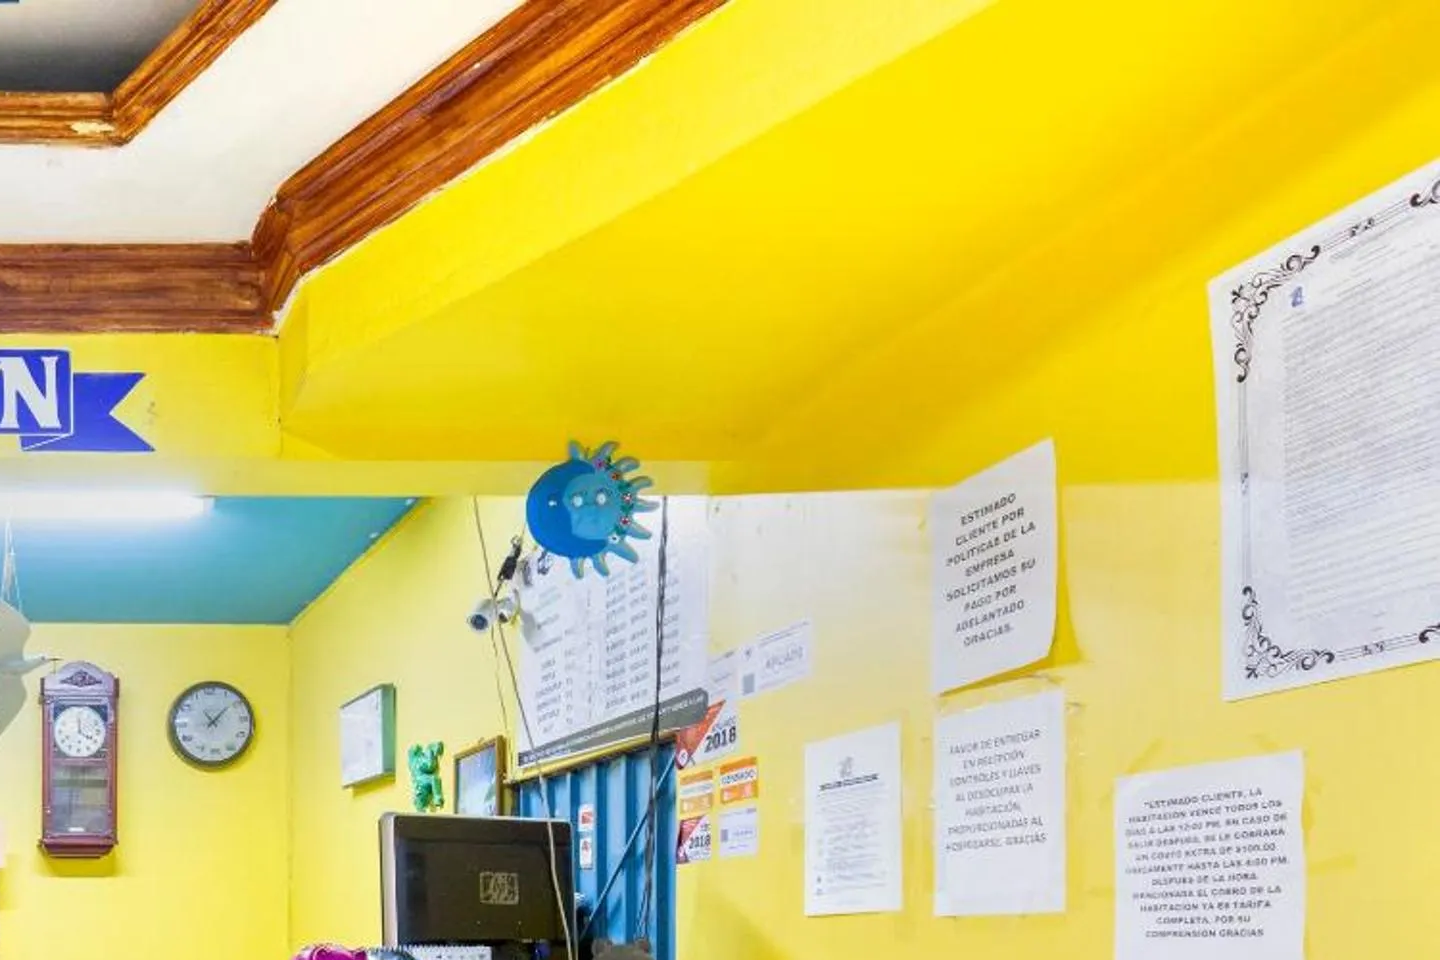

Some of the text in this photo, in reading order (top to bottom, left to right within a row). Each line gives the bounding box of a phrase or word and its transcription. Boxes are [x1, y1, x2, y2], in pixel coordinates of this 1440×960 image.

[961, 493, 1016, 526] ESTIMADO
[956, 507, 1024, 546] CLIENTE POR
[1003, 529, 1017, 542] DE
[1021, 521, 1036, 535] LA
[965, 549, 1014, 577] EMPRESA
[946, 558, 1035, 602] SOLICITAMOS SU
[964, 585, 1016, 612] PAGO POR
[956, 600, 1024, 632] ADELANTADO
[703, 725, 737, 754] 2018
[950, 729, 1040, 754] FAVOR DE ENTREGAR
[963, 759, 976, 769] EN
[1249, 787, 1263, 797] LA
[1190, 806, 1221, 817] VENCE
[1225, 801, 1258, 813] TODOS
[1261, 799, 1282, 809] LOS
[1225, 818, 1239, 827] EN
[1242, 814, 1270, 826] CASO
[1273, 812, 1287, 823] DE
[1185, 847, 1216, 858] EXTRA
[1219, 845, 1232, 855] DE
[1187, 860, 1220, 871] HASTA
[1196, 887, 1209, 898] EL
[1211, 886, 1247, 896] COBRO
[1267, 884, 1282, 894] LA
[1201, 901, 1215, 911] YA
[1233, 899, 1271, 909] TARIFA
[1215, 914, 1234, 924] POR
